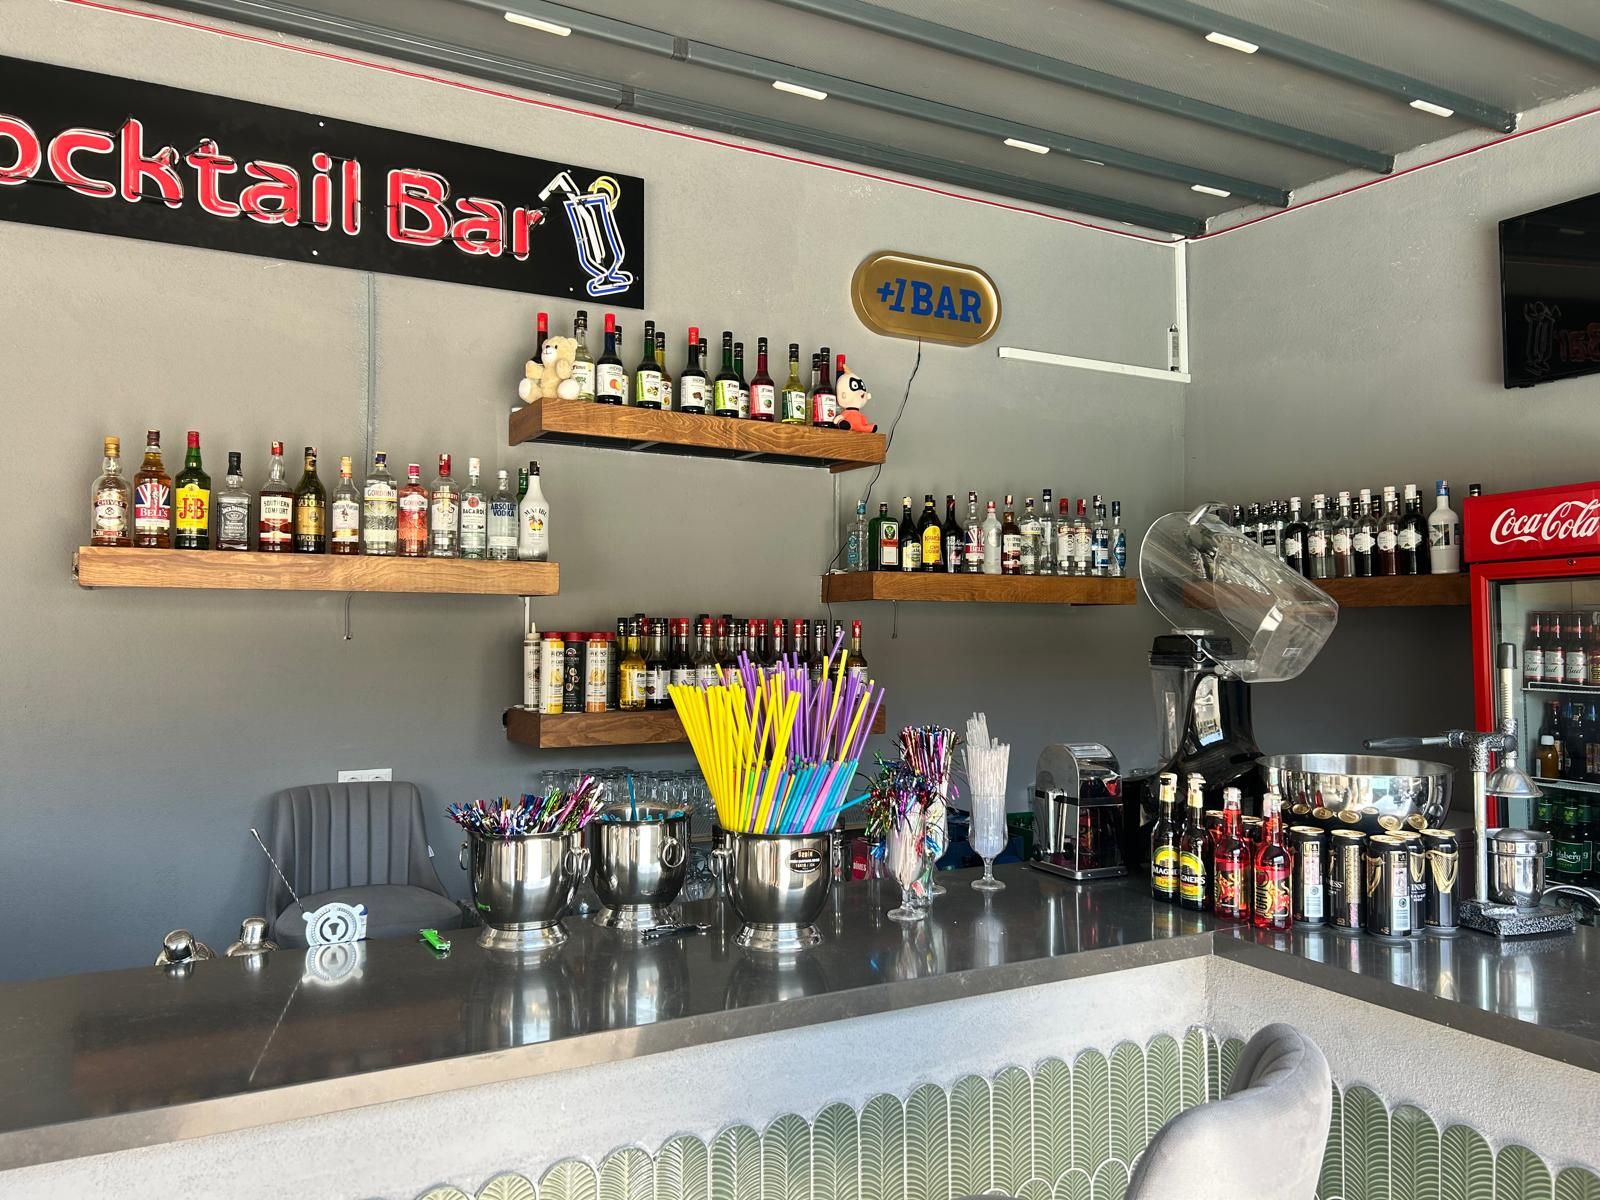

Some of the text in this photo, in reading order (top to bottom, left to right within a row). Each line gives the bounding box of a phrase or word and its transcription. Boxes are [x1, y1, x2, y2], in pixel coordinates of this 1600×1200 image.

[0, 114, 545, 260] ocktail Bar
[179, 497, 205, 520] J&B
[491, 503, 517, 511] ABSOLUT
[1490, 498, 1600, 545] Coca-Cola
[1181, 874, 1206, 885] GNERS
